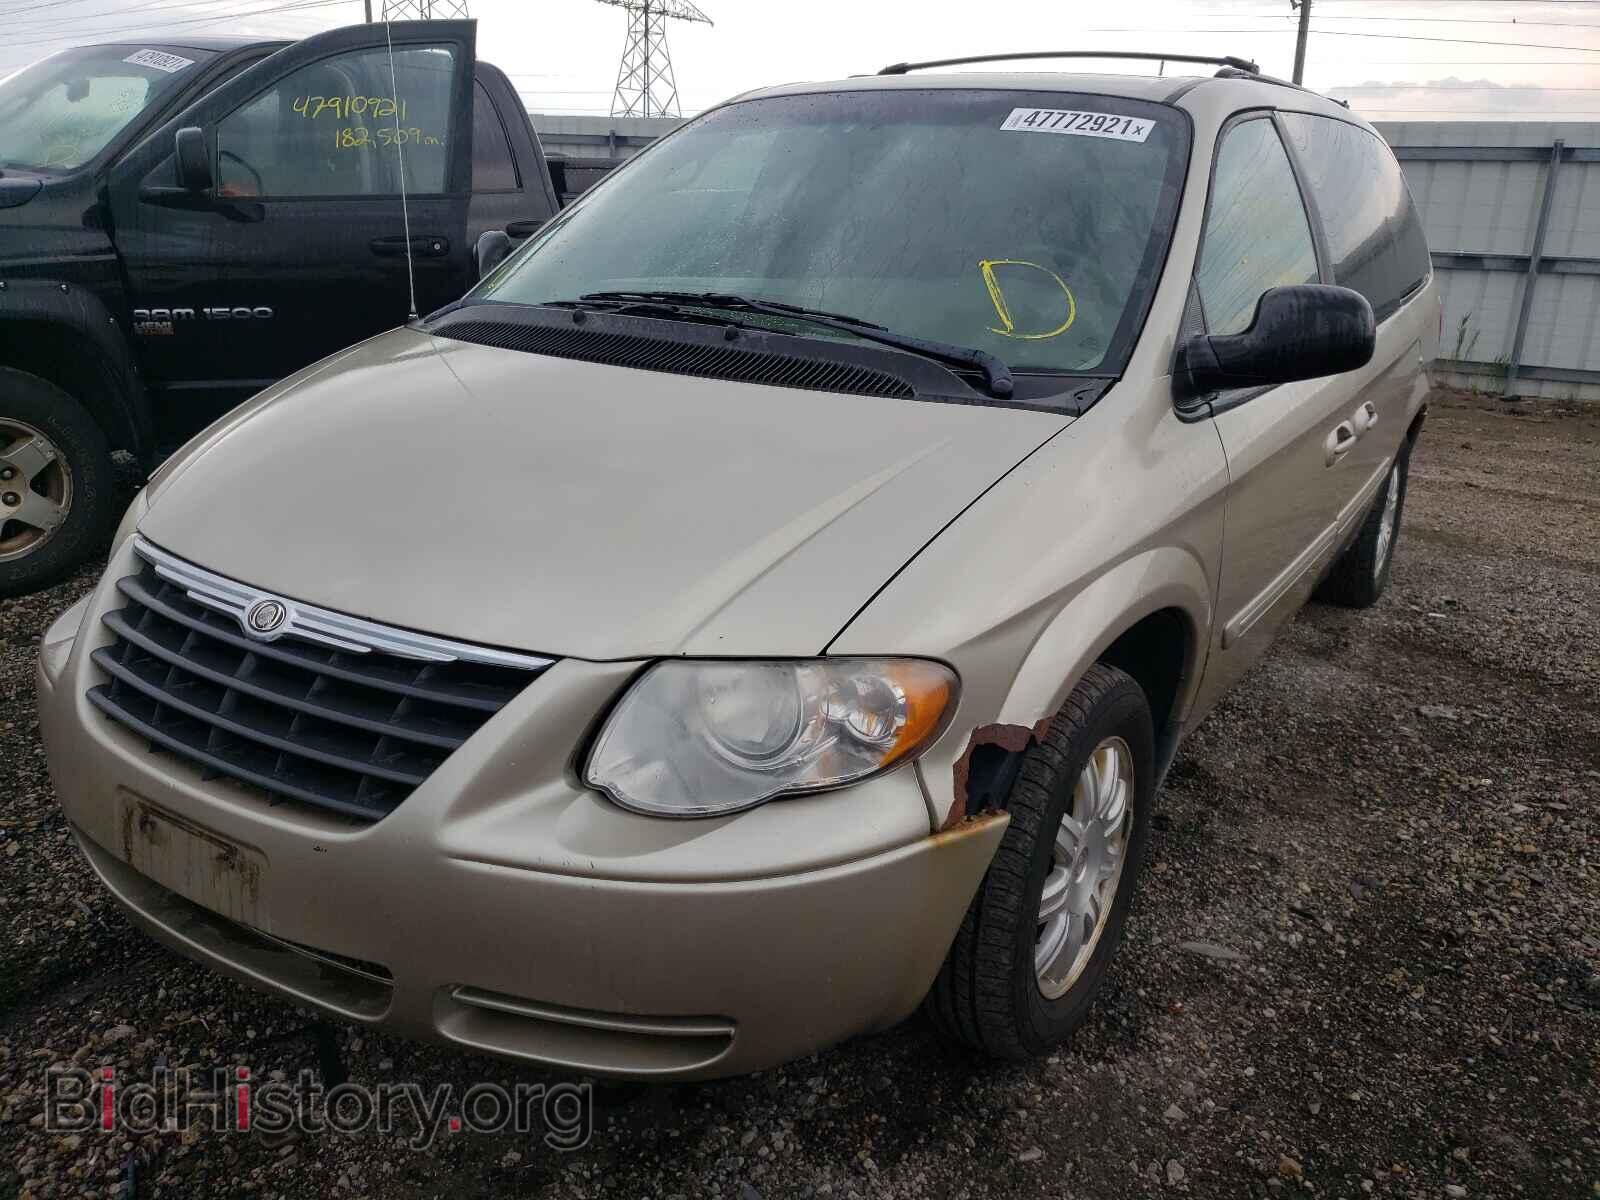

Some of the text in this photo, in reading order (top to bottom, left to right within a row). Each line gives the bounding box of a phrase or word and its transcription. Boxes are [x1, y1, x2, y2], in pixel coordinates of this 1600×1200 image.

[293, 95, 406, 120] 47910921
[979, 259, 1076, 340] D
[133, 306, 273, 321] RAM 1500
